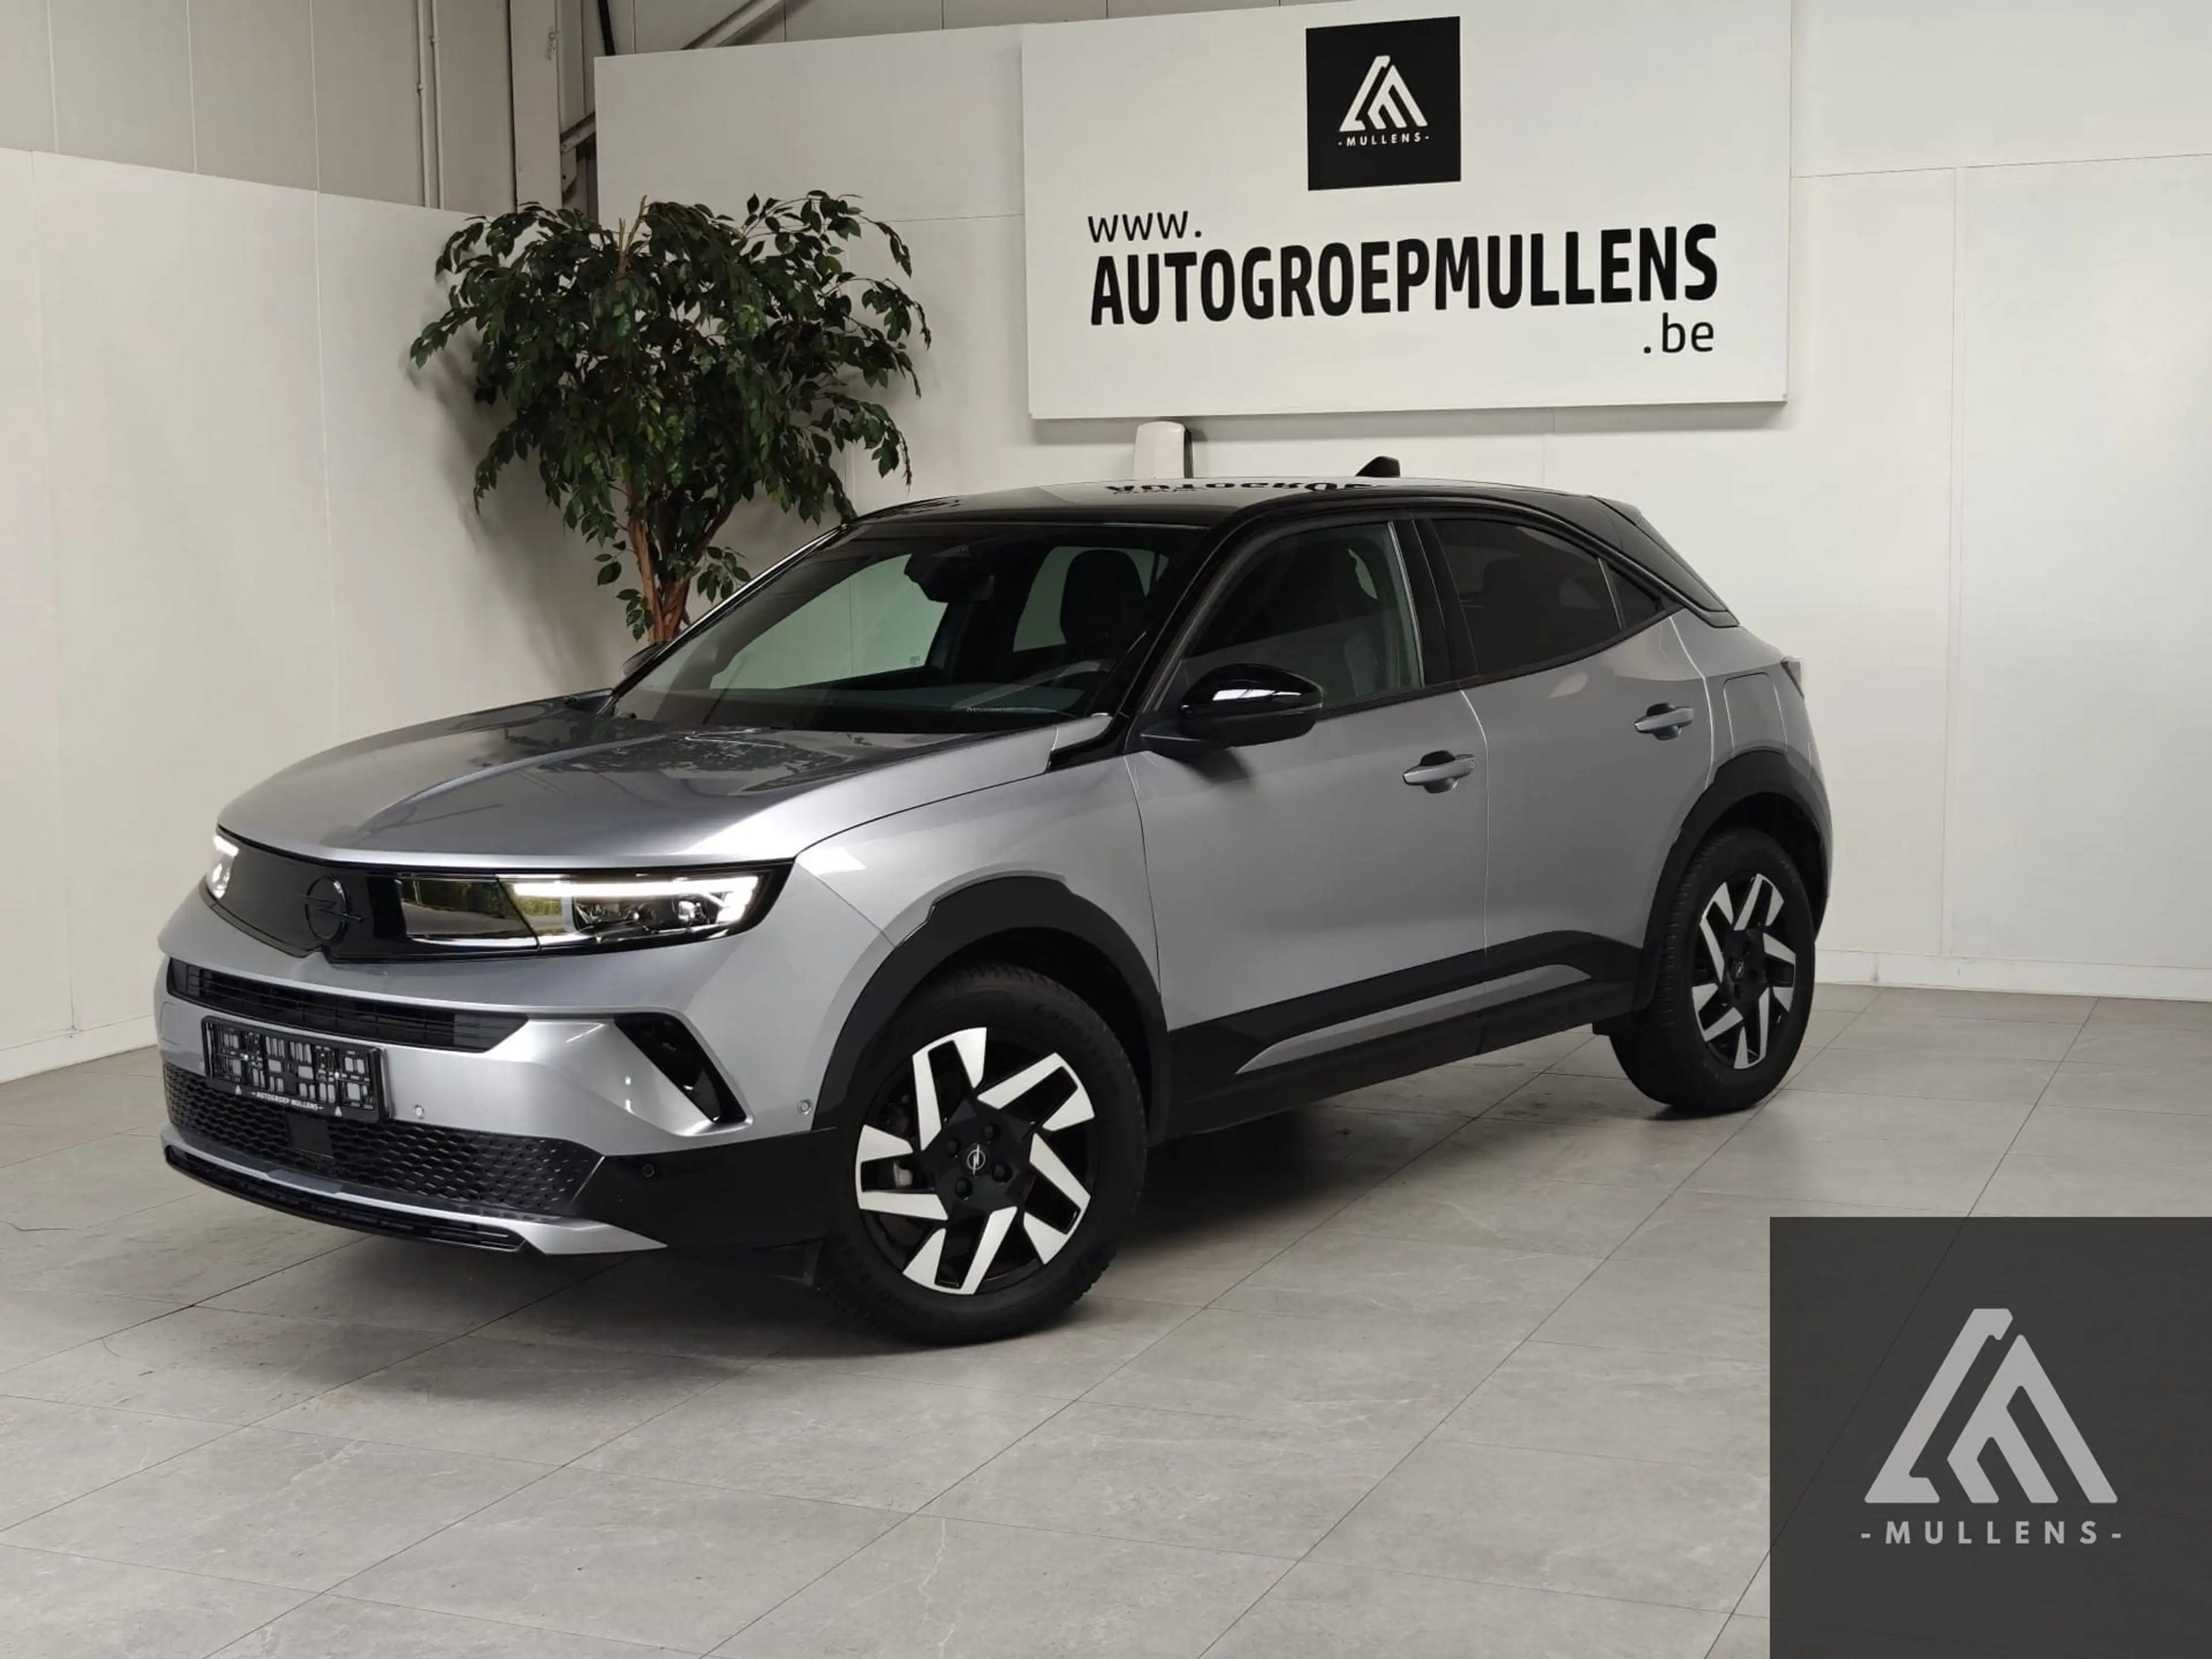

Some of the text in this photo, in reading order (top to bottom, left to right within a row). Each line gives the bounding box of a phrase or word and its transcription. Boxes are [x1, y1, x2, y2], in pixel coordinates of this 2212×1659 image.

[1088, 210, 1202, 243] www.
[1092, 224, 1717, 325] AUTOGROEPMULLENS
[1643, 312, 1714, 354] .be
